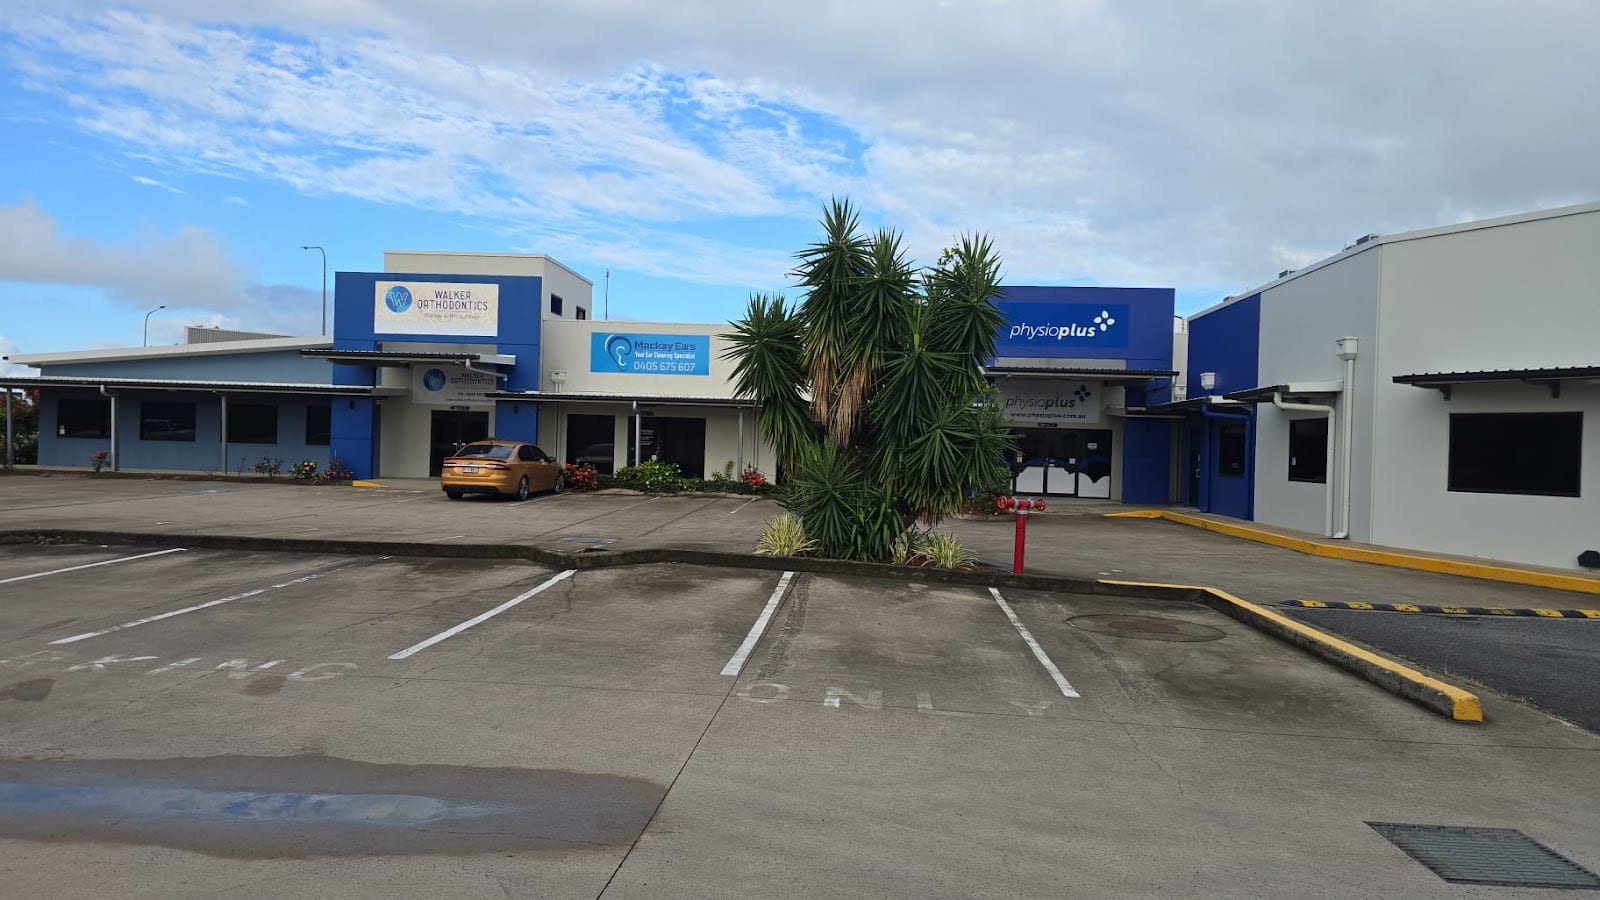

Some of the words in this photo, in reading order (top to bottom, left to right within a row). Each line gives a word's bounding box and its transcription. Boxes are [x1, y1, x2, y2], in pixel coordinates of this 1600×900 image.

[434, 290, 471, 300] WALKER
[416, 300, 488, 311] ORTHODONTICS
[1009, 322, 1096, 340] physioplus
[634, 341, 674, 351] Mackay
[675, 343, 696, 351] Ears
[633, 361, 658, 371] 0405
[659, 361, 676, 372] 675
[678, 362, 696, 372] 607
[1005, 395, 1076, 410] physioplus
